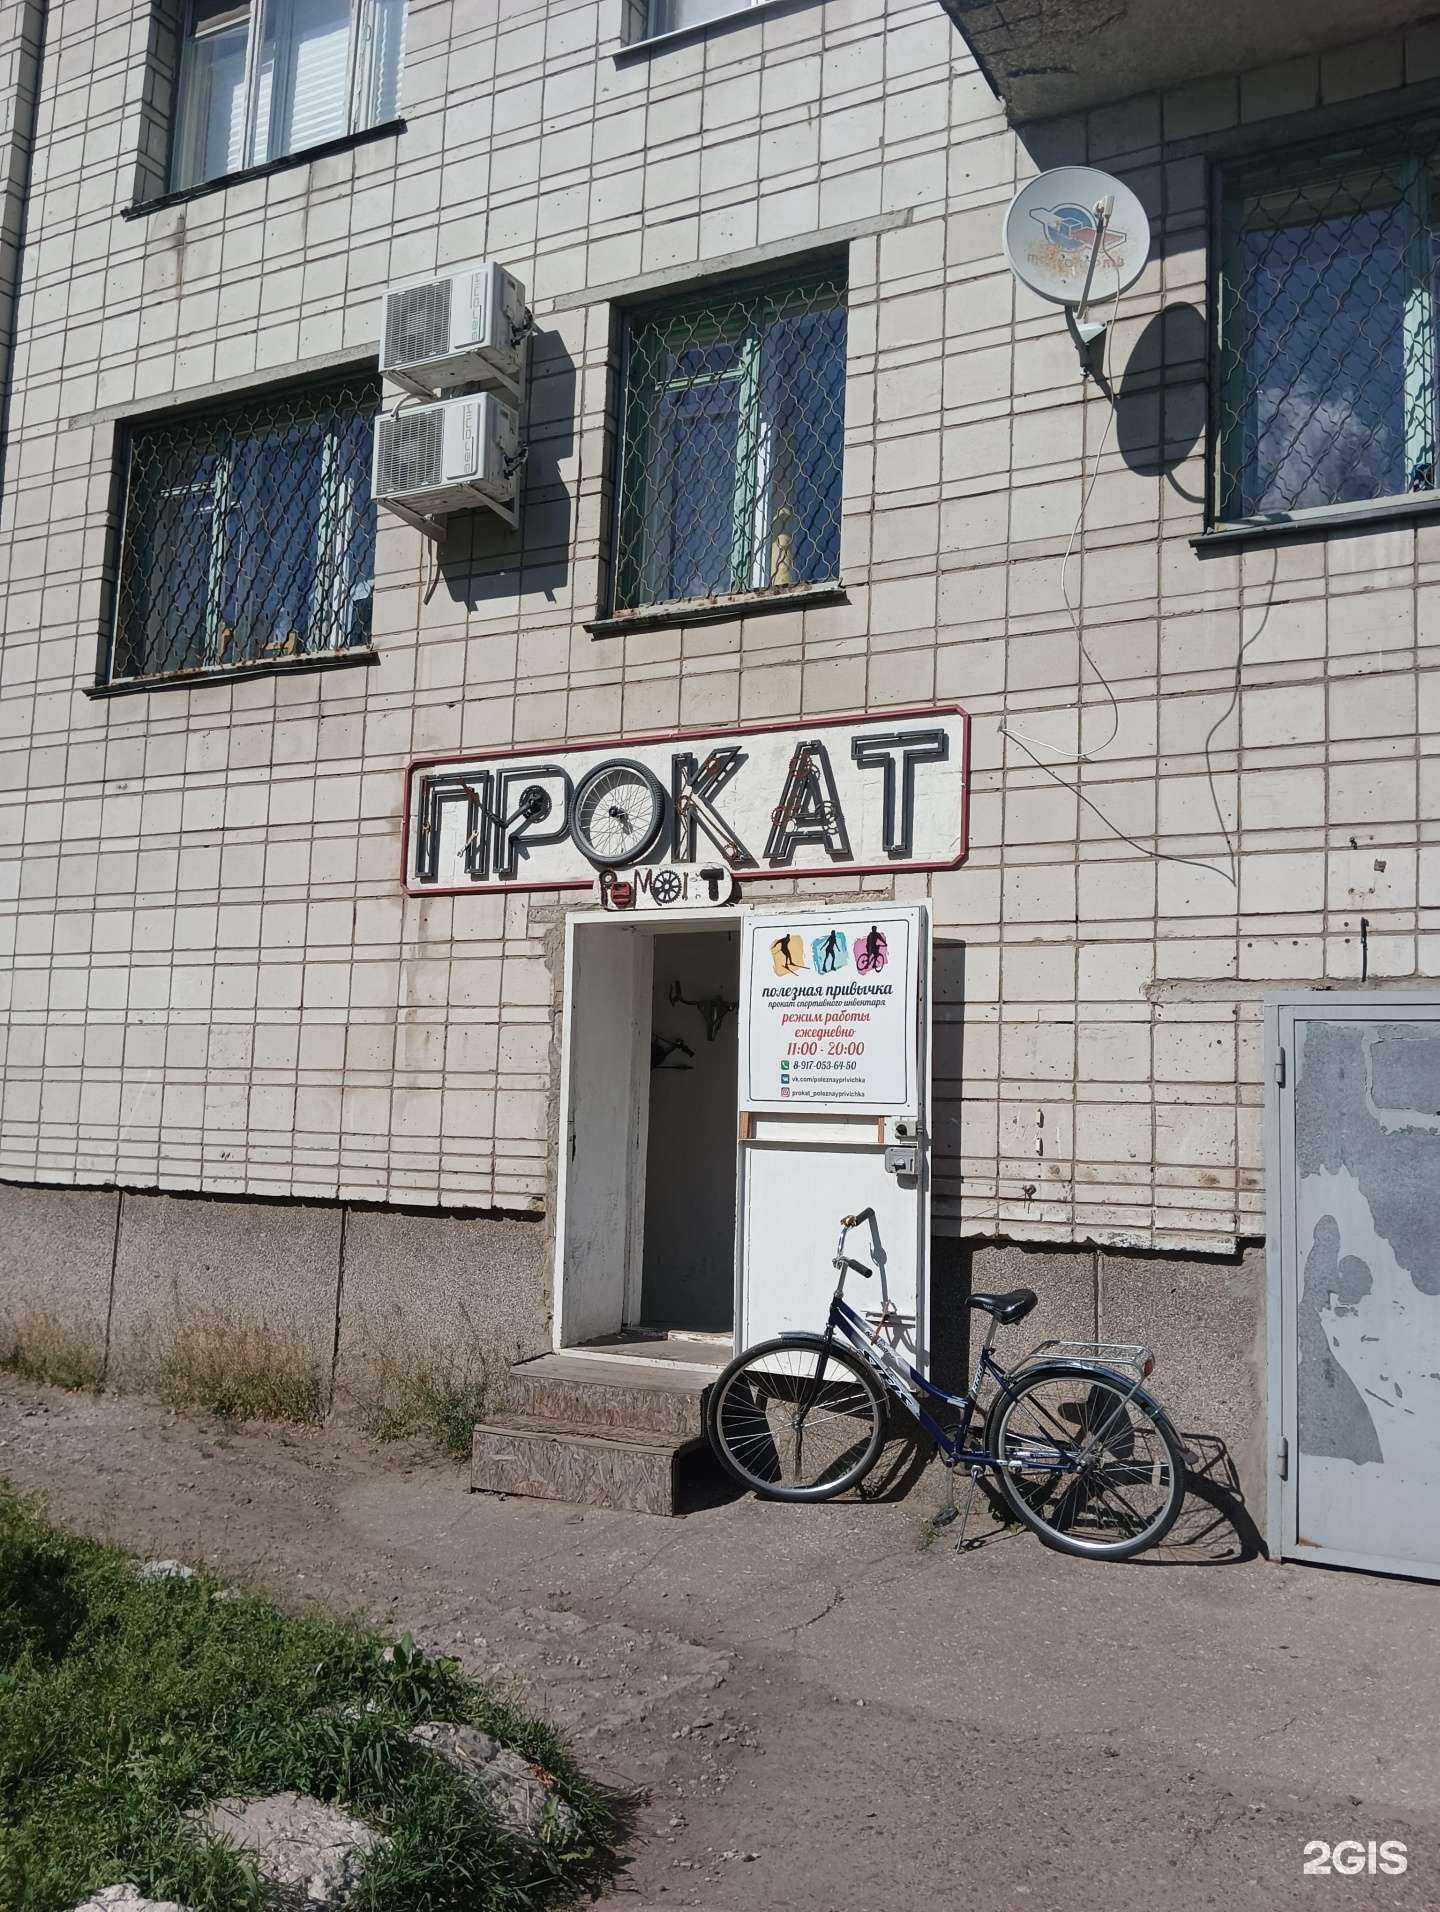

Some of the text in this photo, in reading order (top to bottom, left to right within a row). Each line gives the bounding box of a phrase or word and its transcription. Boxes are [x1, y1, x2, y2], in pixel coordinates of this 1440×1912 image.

[415, 728, 945, 877] ПРОКАТ
[762, 981, 893, 1000] полезная привычка
[768, 998, 886, 1009] прокат спортивного инвентаря
[781, 1010, 871, 1026] режим работы
[795, 1025, 856, 1041] ежедневно
[787, 1042, 818, 1056] 11:00
[827, 1042, 865, 1056] 20:00
